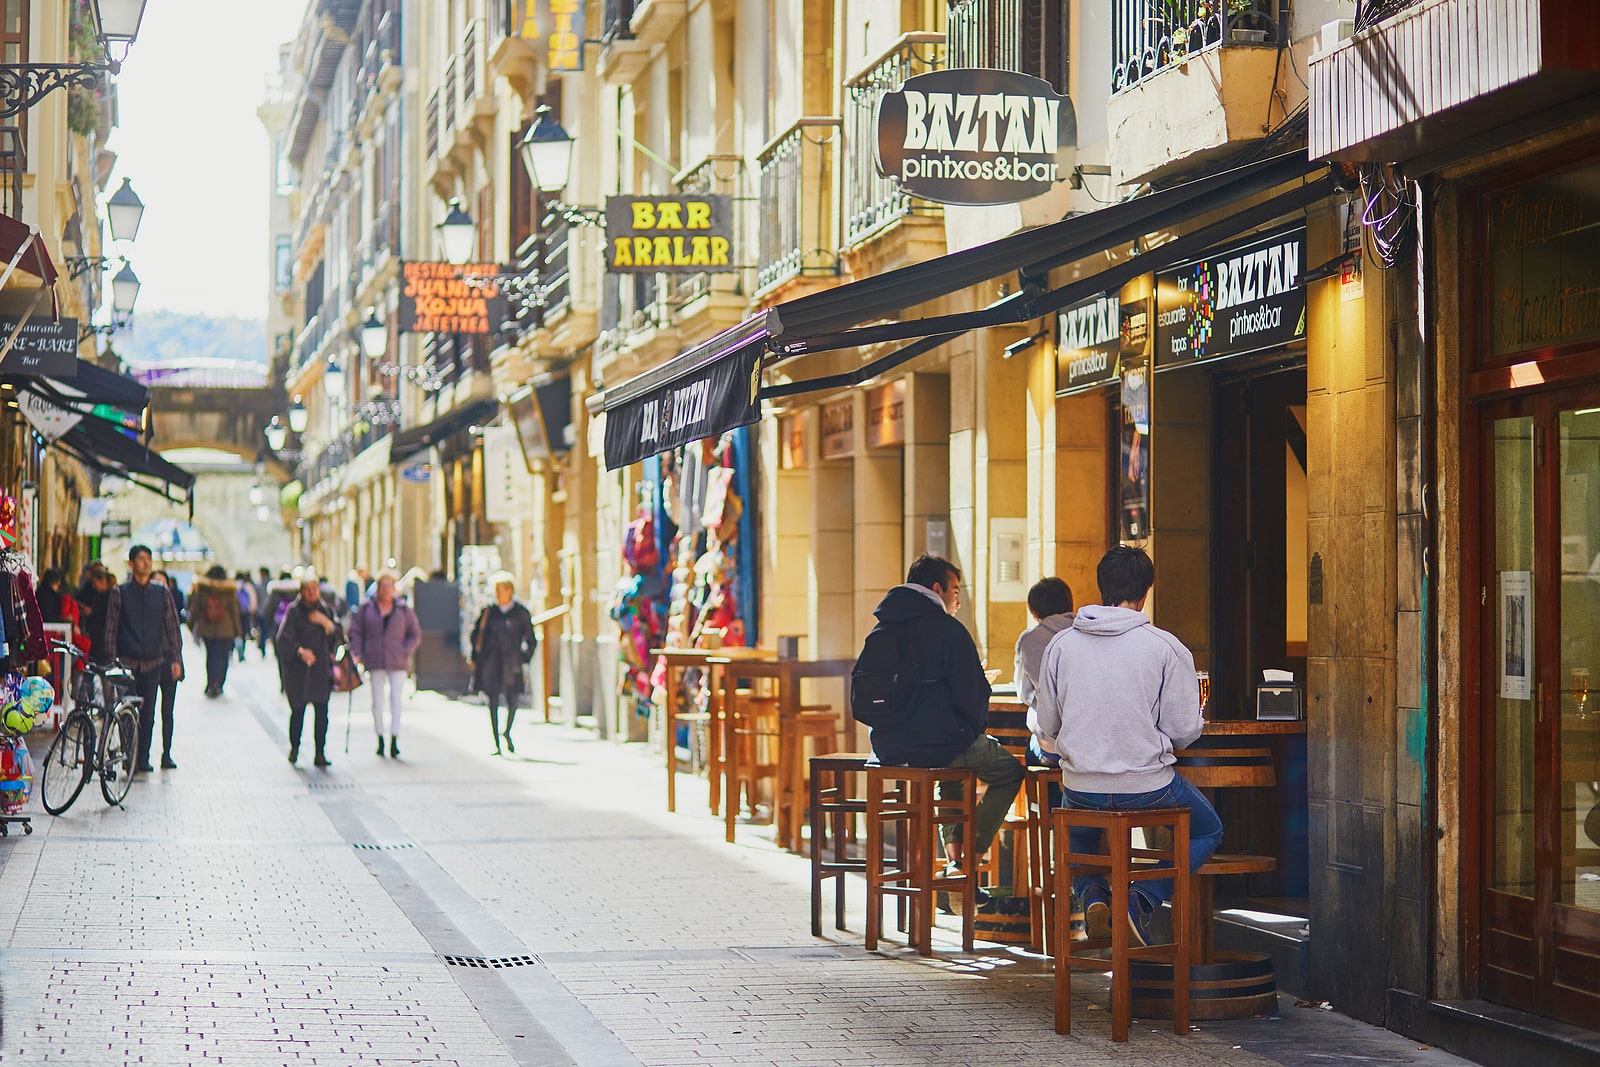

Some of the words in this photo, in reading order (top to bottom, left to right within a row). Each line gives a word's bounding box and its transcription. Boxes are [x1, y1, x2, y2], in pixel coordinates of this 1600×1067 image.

[903, 90, 1060, 154] BAZTAN
[902, 154, 1060, 182] pintxos&bar
[631, 201, 711, 230] BAR
[613, 236, 730, 267] ARALAR
[1216, 241, 1299, 311] BAZTAN
[3, 322, 63, 334] Reaurante
[1059, 297, 1119, 353] BAZTAN
[1230, 304, 1282, 344] pintxos&bar
